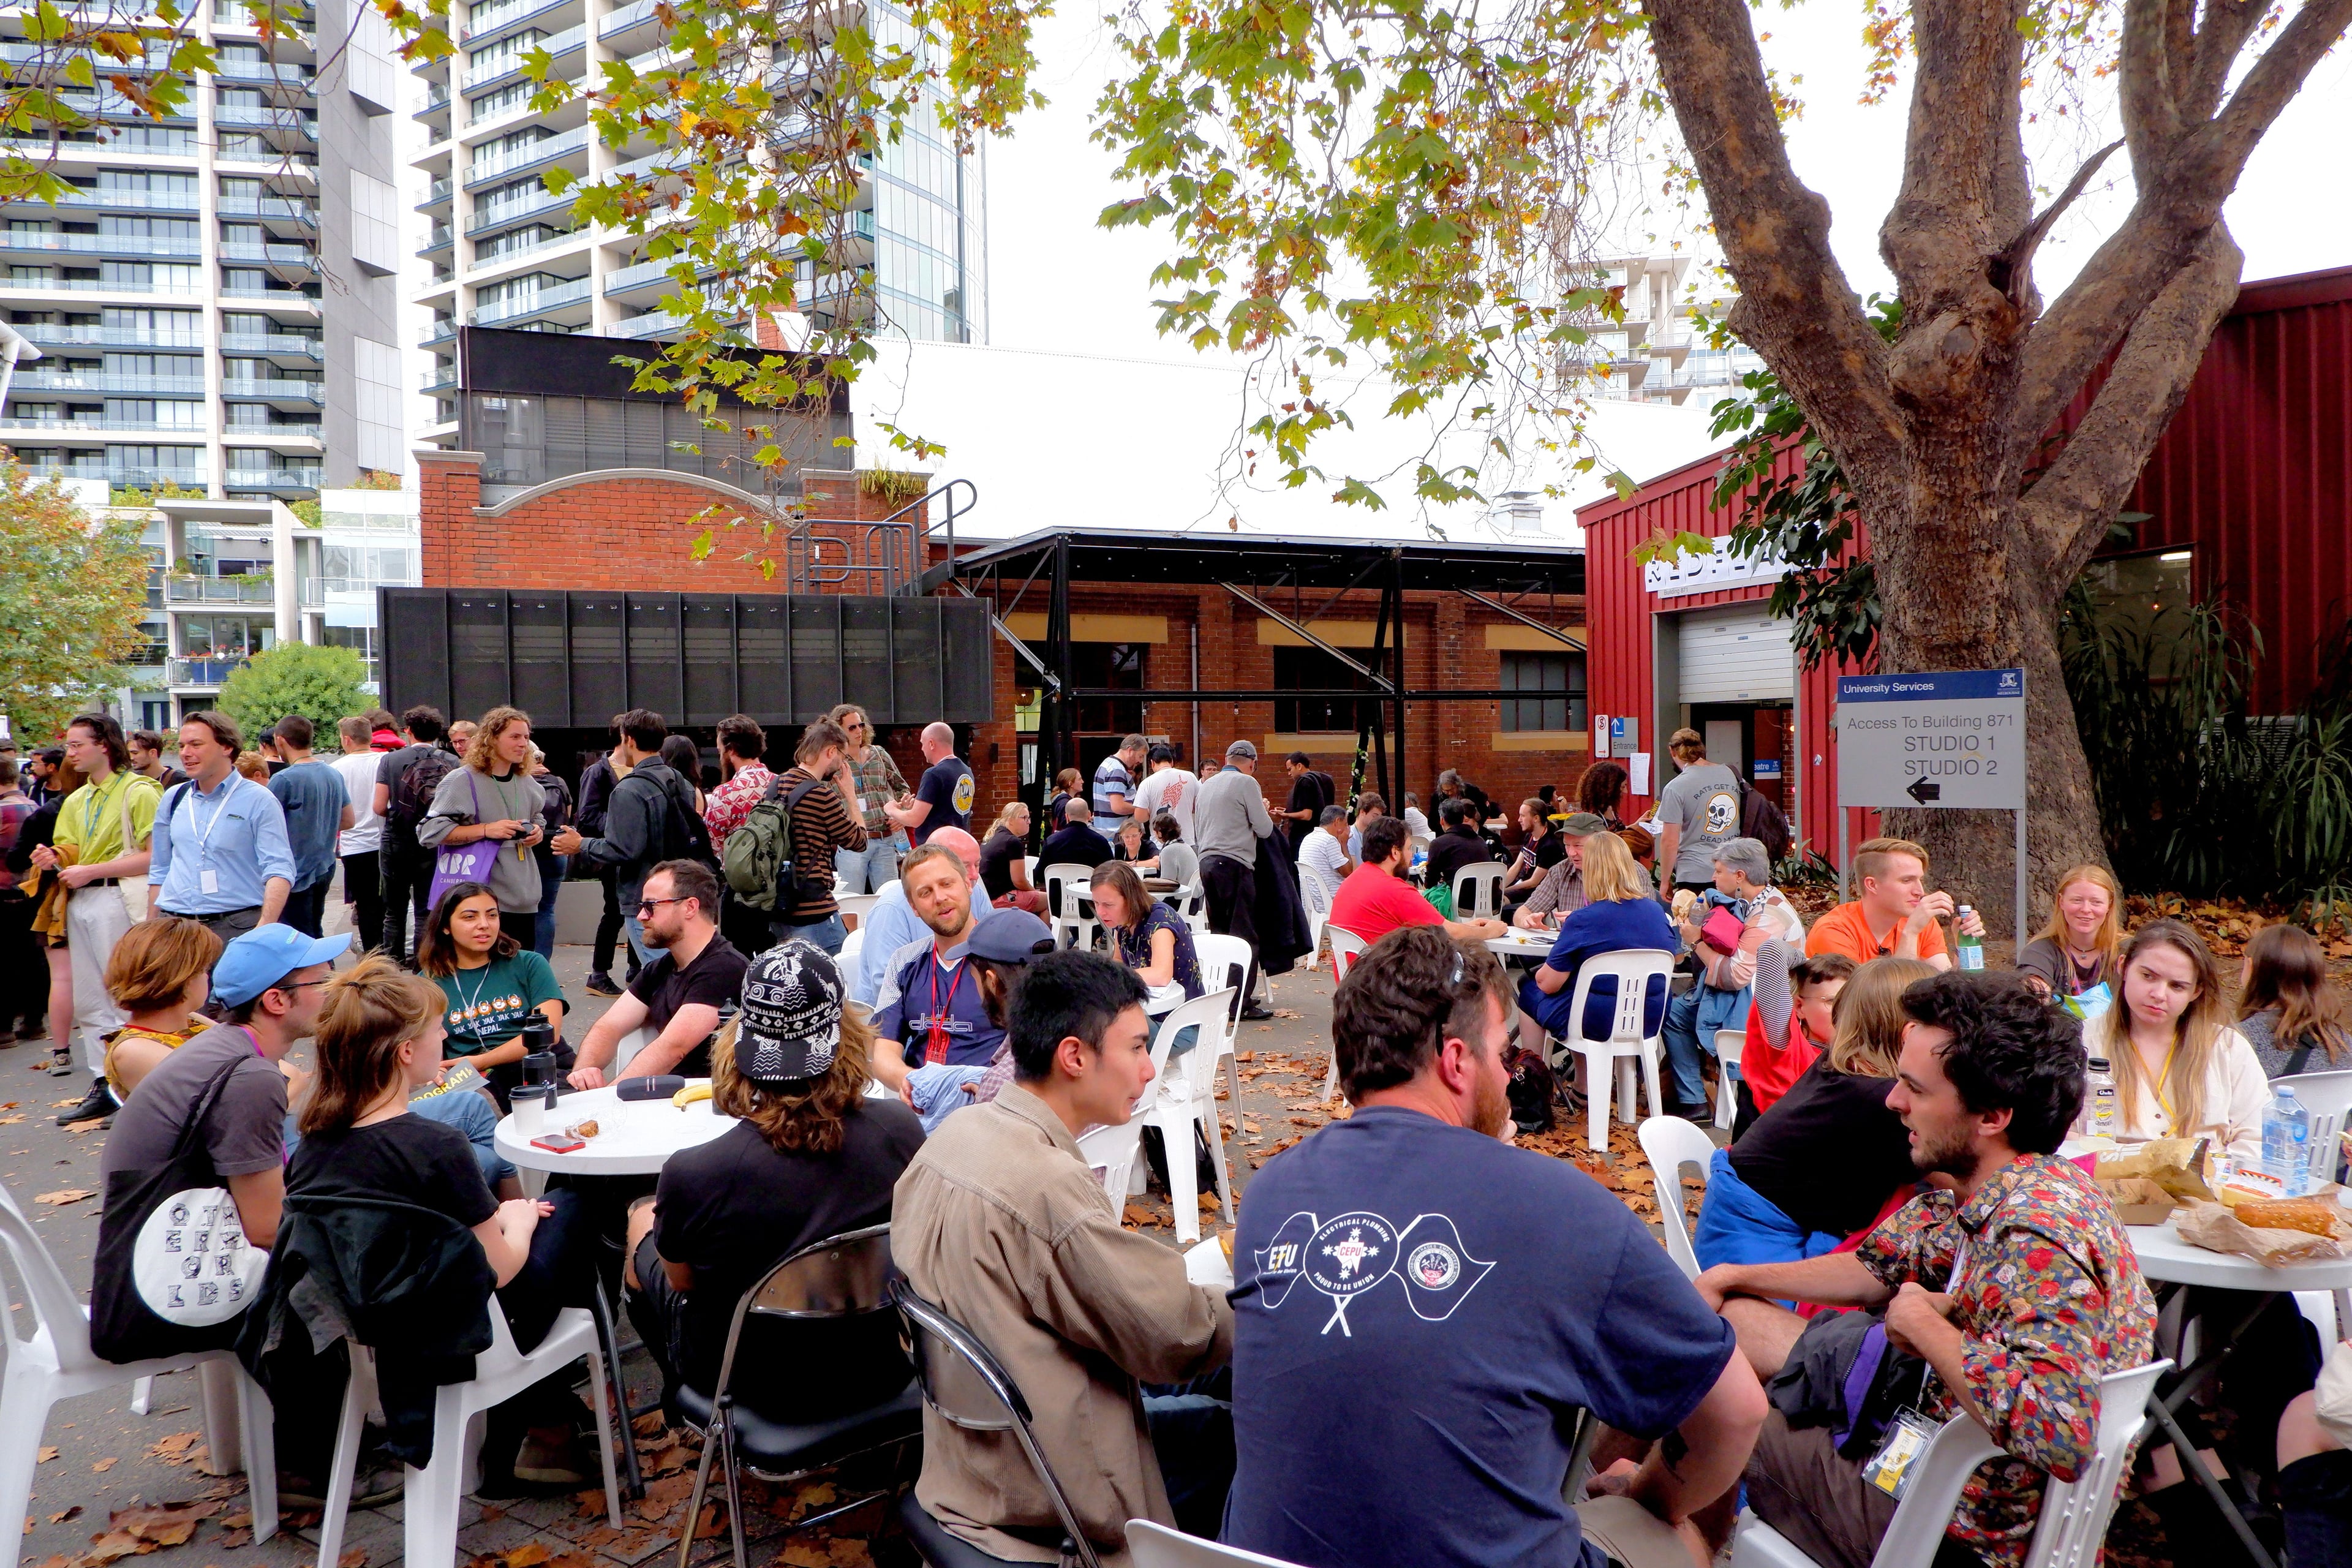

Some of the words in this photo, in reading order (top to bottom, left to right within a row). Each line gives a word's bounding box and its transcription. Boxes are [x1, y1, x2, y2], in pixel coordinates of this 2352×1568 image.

[1844, 685, 1890, 694] University
[1892, 682, 1934, 692] Services
[1847, 718, 1897, 729] Access
[1901, 716, 1917, 729] To
[1923, 715, 1981, 730] Building
[1987, 714, 2013, 727] 871
[1613, 741, 1637, 750] Entrance
[1904, 735, 1979, 752] STUDIO
[1988, 736, 1994, 750] 1
[1904, 760, 1979, 775] STUDIO
[1986, 760, 1997, 775] 2
[1694, 785, 1713, 800] RATS
[1700, 835, 1722, 843] DEAD
[453, 1025, 466, 1035] YAK
[482, 1016, 495, 1025] YAK
[478, 1023, 502, 1035] NEPAL
[1319, 1218, 1360, 1240] ELECTRICAL
[1362, 1218, 1390, 1242] PLUMBING
[1268, 1244, 1298, 1270] ETU
[1340, 1246, 1362, 1256] CEPU
[1314, 1272, 1332, 1288] PROUD
[1353, 1273, 1374, 1289] UNION
[1446, 1272, 1457, 1284] UNION
